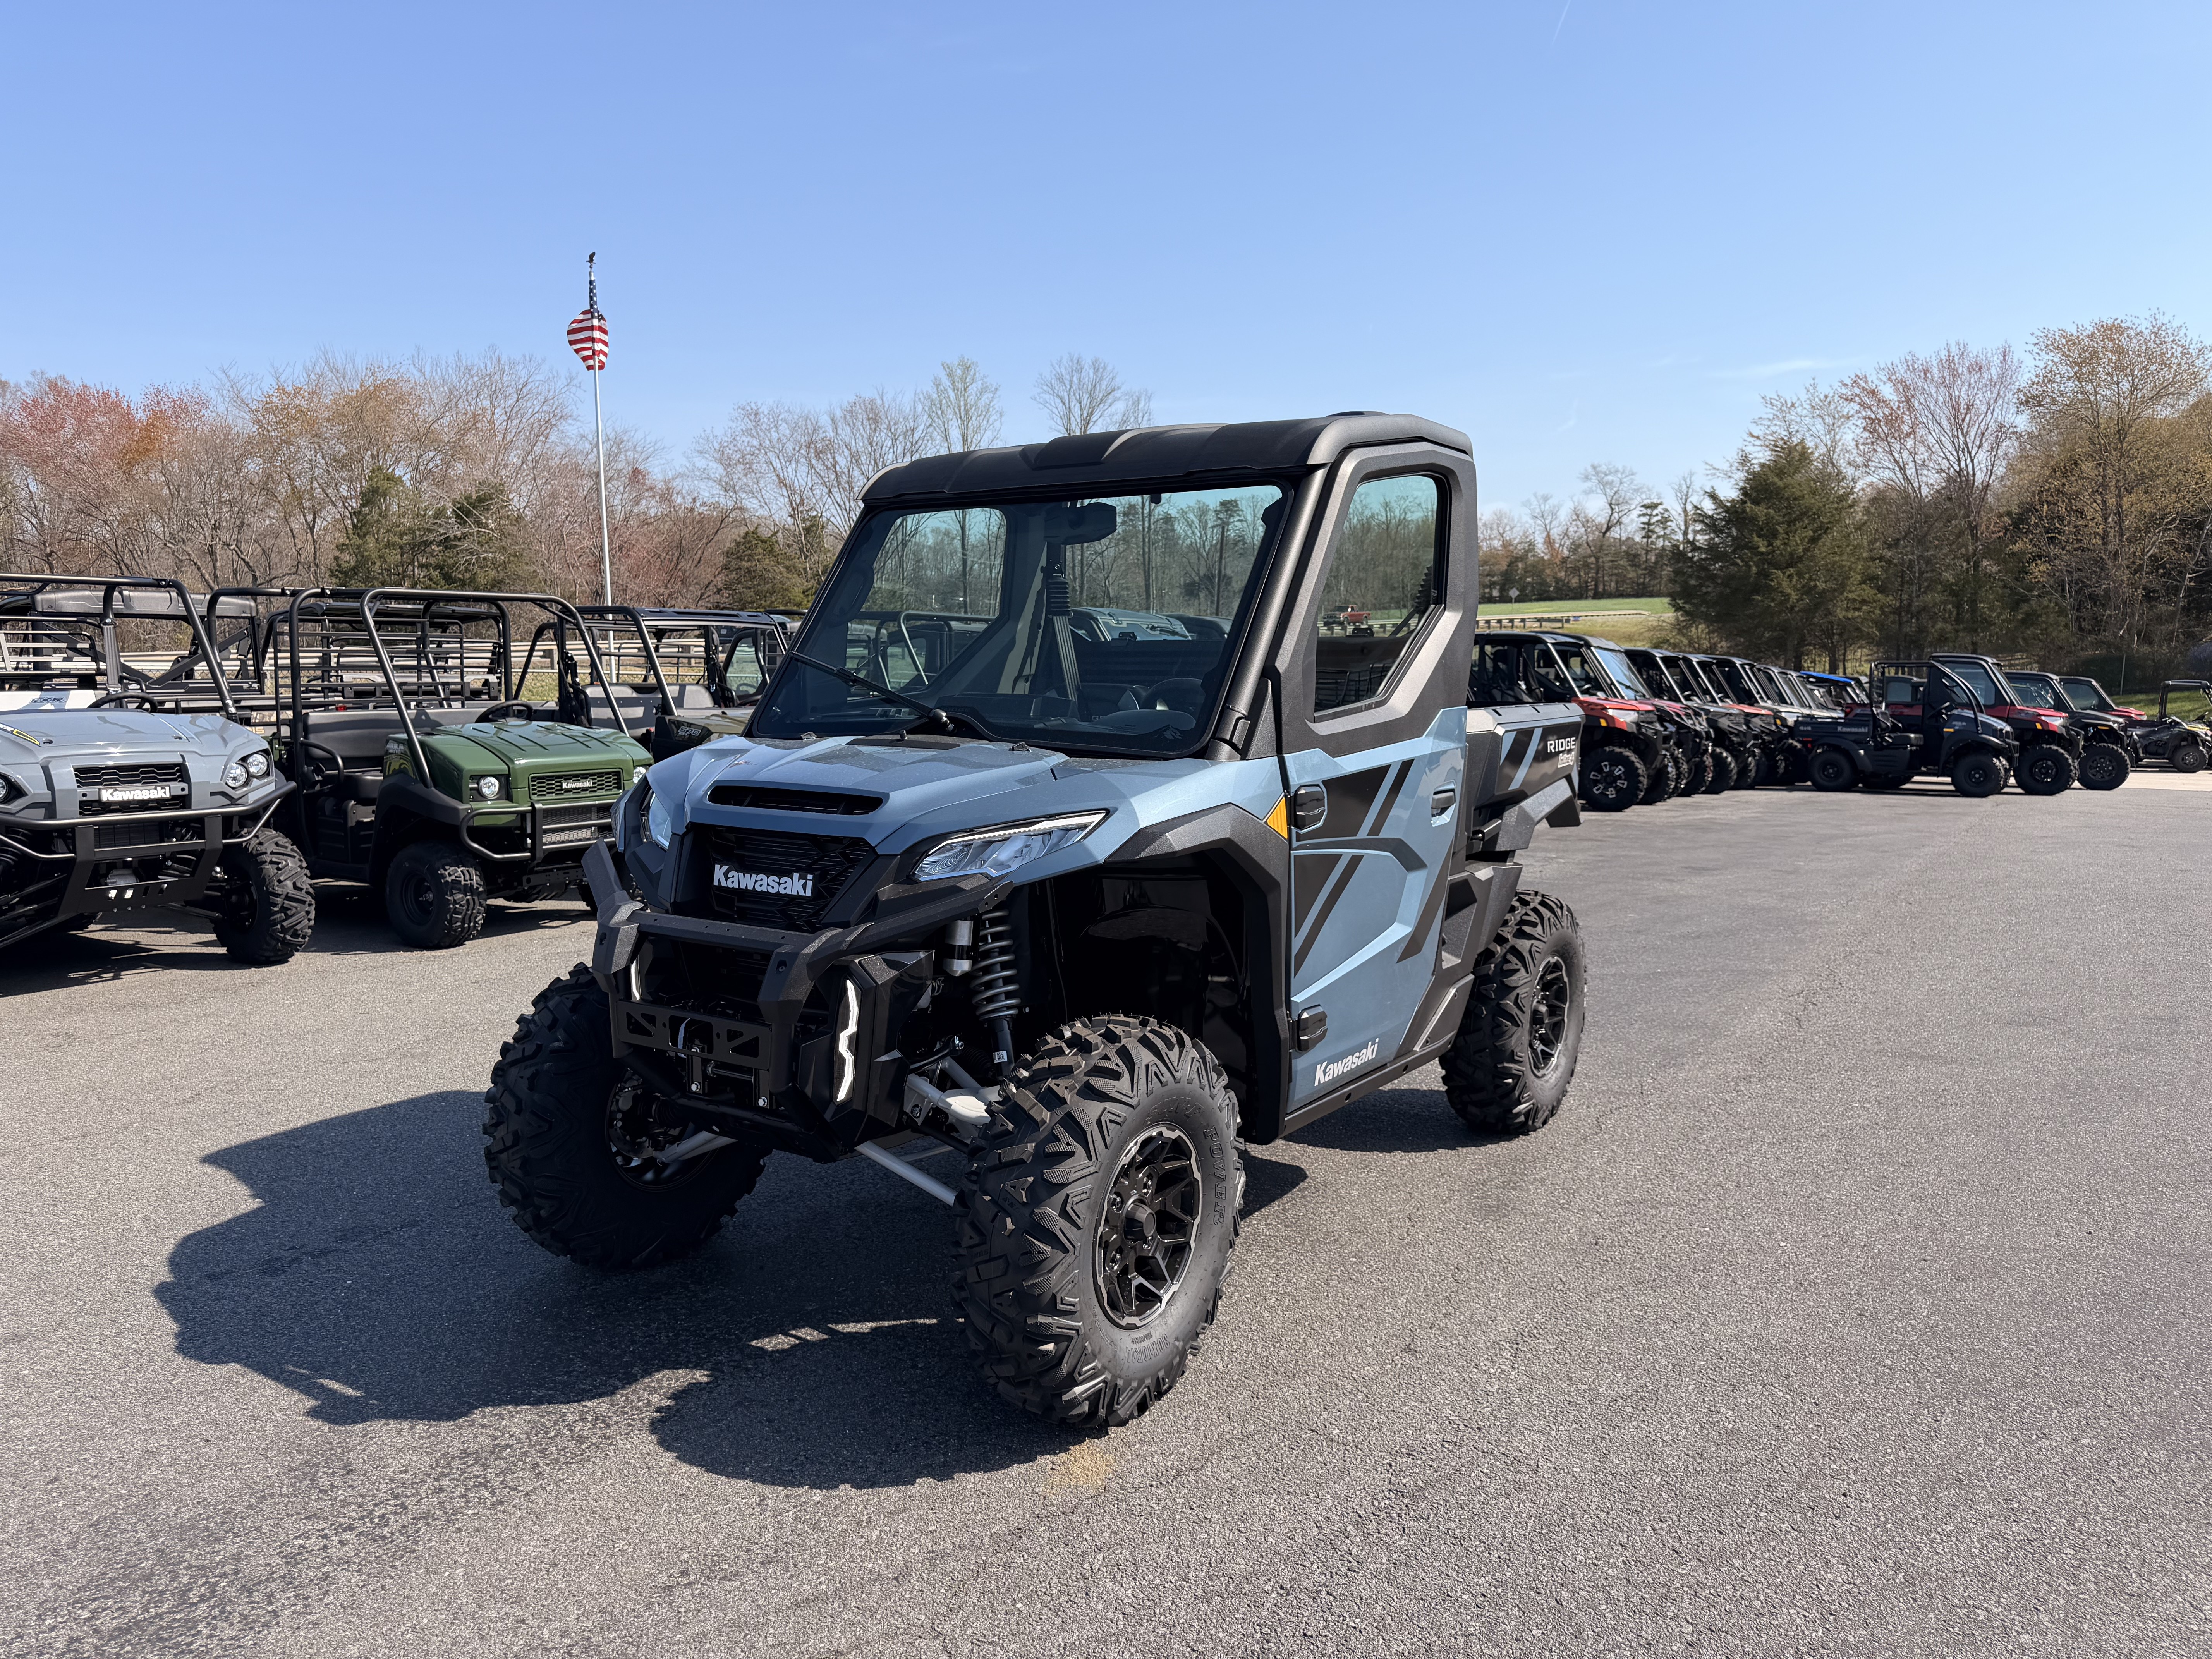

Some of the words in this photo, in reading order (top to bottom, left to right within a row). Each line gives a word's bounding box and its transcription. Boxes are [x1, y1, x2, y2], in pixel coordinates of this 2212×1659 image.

[1547, 737, 1575, 753] RIDGE
[102, 786, 170, 801] Kawasaki
[563, 779, 592, 789] Kawasaki
[713, 864, 813, 896] Kawasaki
[1314, 1038, 1379, 1086] Kawasaki
[1203, 1125, 1226, 1225] POWER
